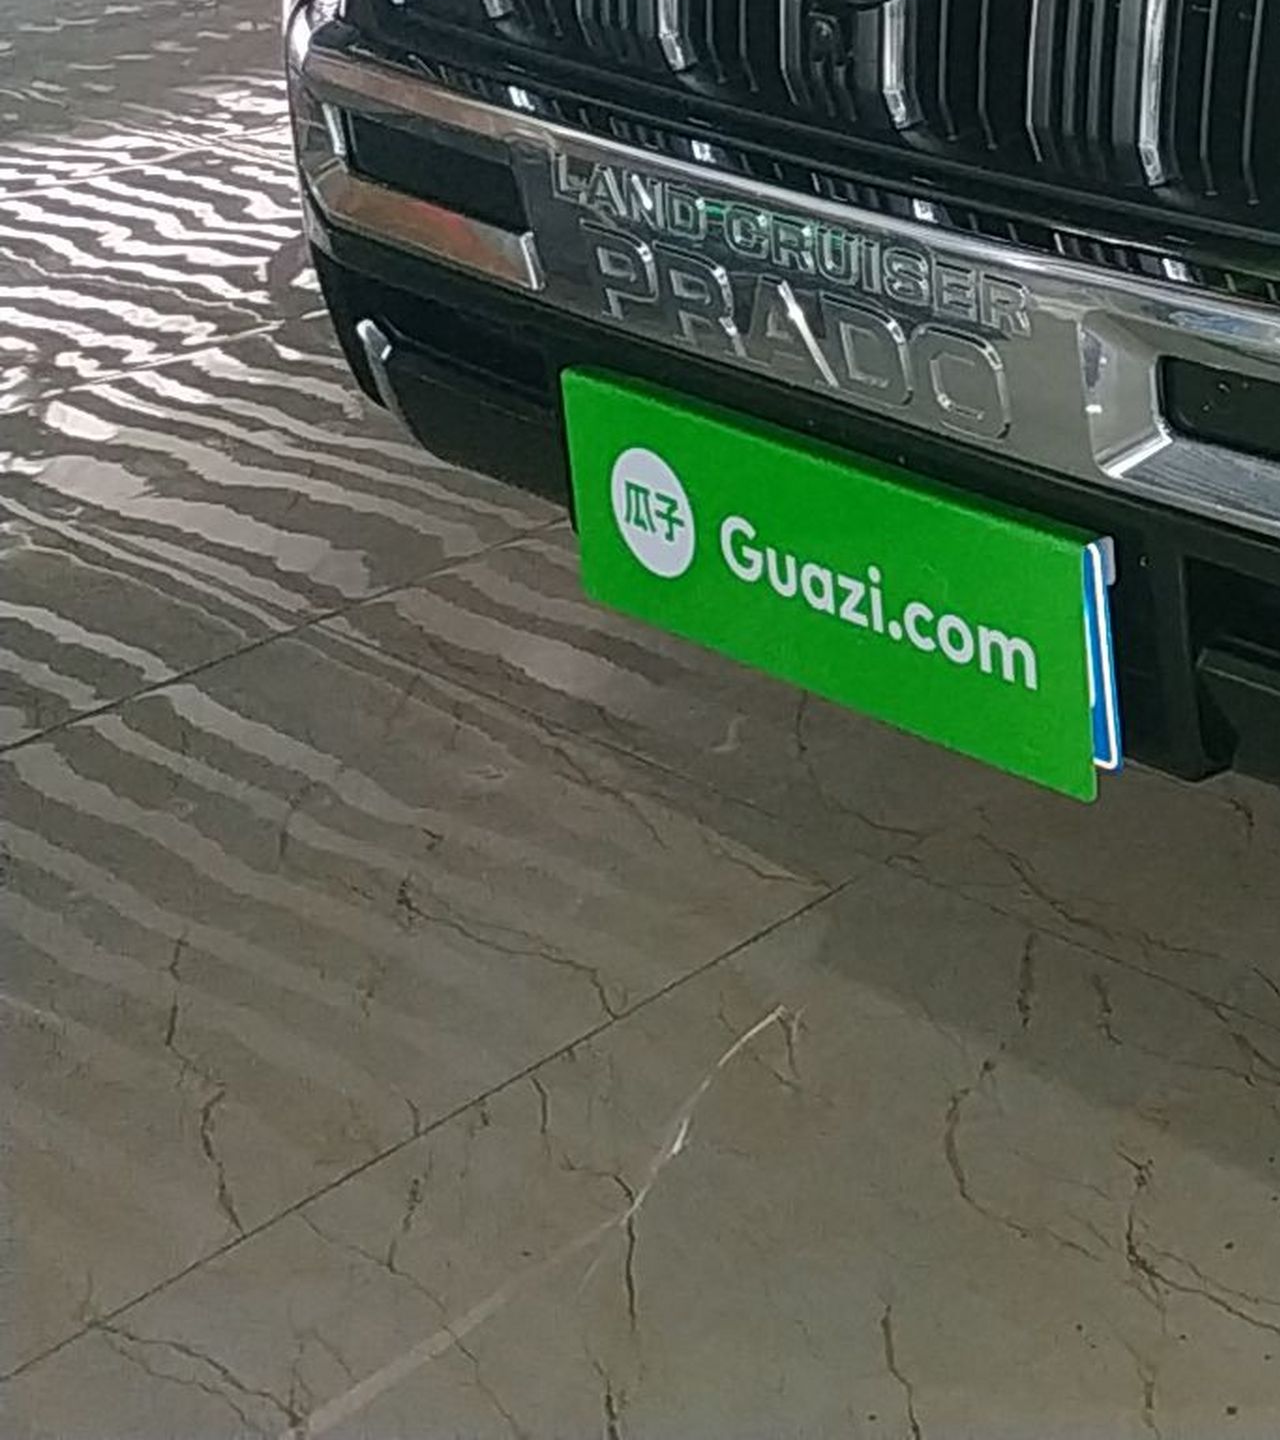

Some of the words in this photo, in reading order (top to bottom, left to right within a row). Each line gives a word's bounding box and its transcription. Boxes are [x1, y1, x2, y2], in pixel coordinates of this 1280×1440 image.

[550, 150, 707, 241] LAND
[723, 201, 1032, 338] CRUISER
[579, 217, 1012, 444] PRADO
[624, 479, 685, 543] 瓜子
[719, 515, 1039, 691] Guazi.com
